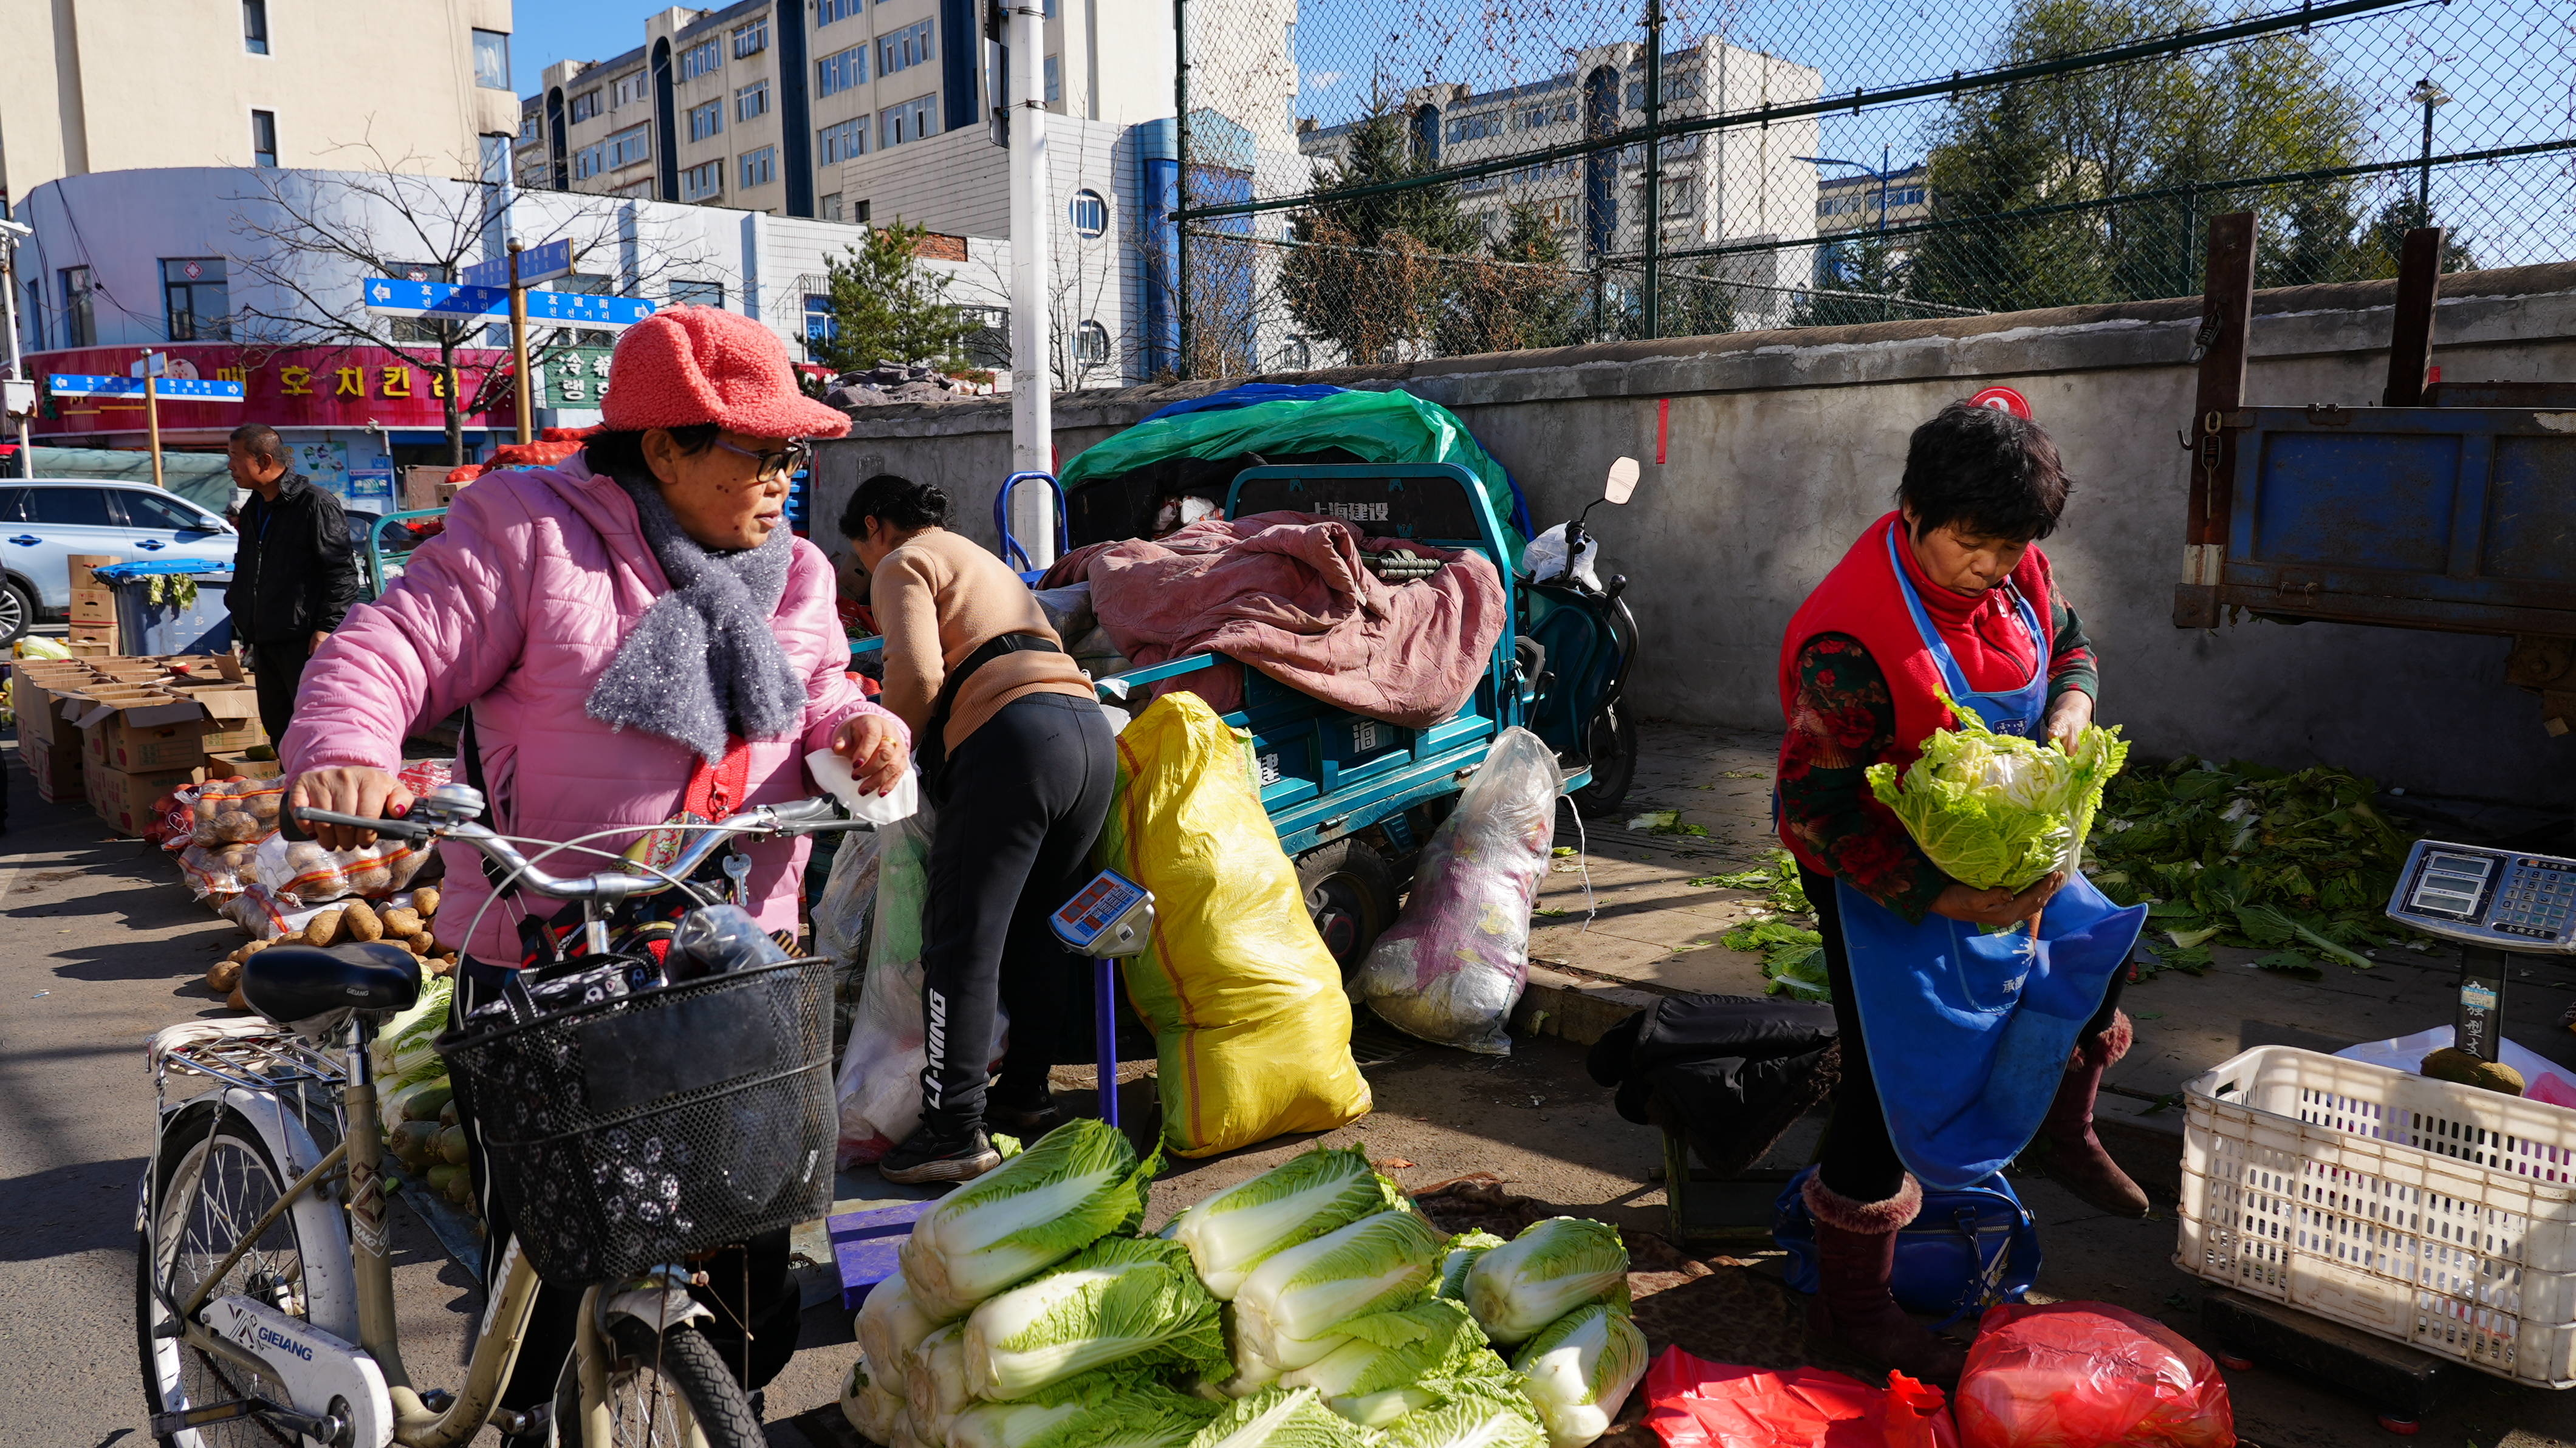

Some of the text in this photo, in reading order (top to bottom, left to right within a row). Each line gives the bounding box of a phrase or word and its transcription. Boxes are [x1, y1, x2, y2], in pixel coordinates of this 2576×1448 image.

[547, 294, 609, 309] 友谊街
[1315, 502, 1389, 521] 上海建设
[1352, 720, 1376, 753] 海
[925, 988, 946, 1110] LI-NING
[482, 1235, 521, 1336] GIELAN
[258, 1327, 313, 1362] GIELANG
